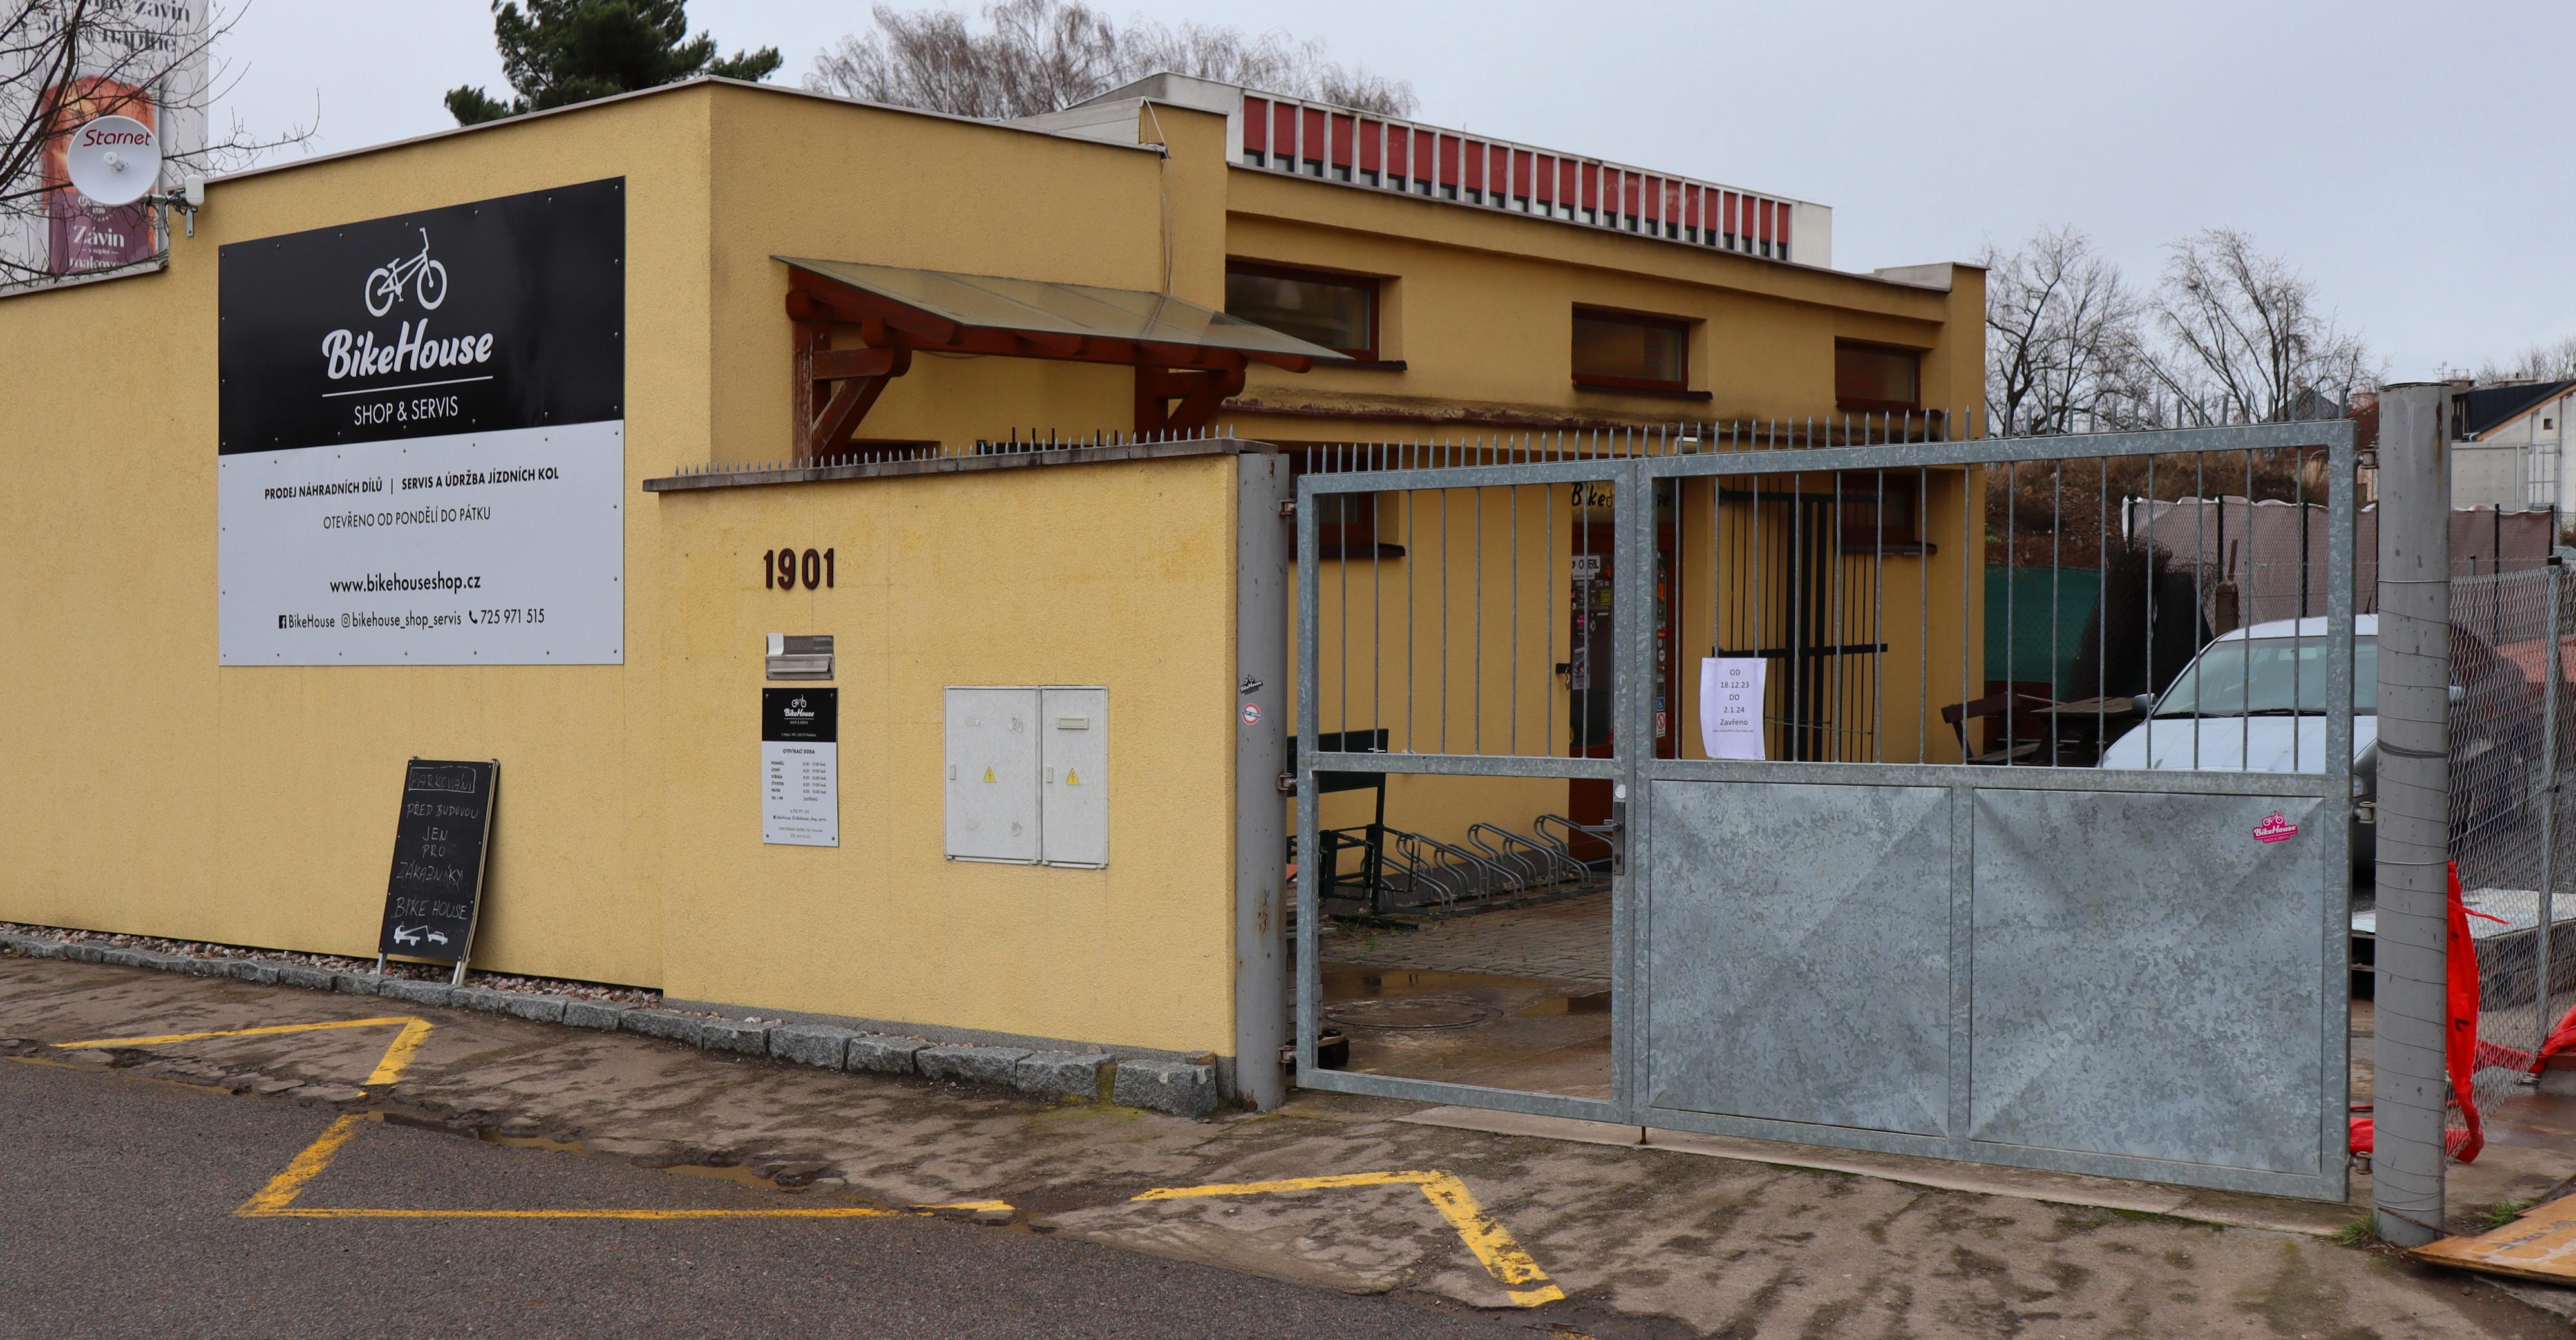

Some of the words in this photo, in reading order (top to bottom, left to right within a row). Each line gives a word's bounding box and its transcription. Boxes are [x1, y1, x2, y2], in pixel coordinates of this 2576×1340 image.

[83, 129, 151, 147] Starnet
[73, 225, 124, 248] Závin
[322, 318, 494, 379] BikeHouse
[354, 403, 393, 426] SHOP
[397, 401, 408, 421] &
[412, 396, 459, 420] SERVIS
[265, 486, 297, 500] PRODEJ
[299, 479, 359, 497] NÁHRADNÍCH
[362, 475, 383, 493] DÍLŮ
[401, 476, 433, 490] SERVIS
[435, 475, 442, 487] A
[445, 469, 486, 487] ÚDRŽBA
[488, 465, 535, 484] JÍZDNÍCH
[538, 467, 559, 481] KOL
[323, 511, 375, 529] OTEVŘENO
[377, 513, 393, 526] OD
[395, 505, 438, 525] PONDĚLÍ
[441, 508, 457, 522] DO
[460, 503, 491, 521] PÁTKU
[763, 548, 834, 590] 1901
[330, 571, 481, 595] www.bikehouseshop.cz
[289, 613, 335, 628] BikeHouse
[352, 609, 461, 630] bikehouse_shop_servis
[480, 609, 500, 624] 725
[504, 609, 521, 624] 971
[526, 608, 545, 624] 515
[784, 708, 815, 717] BikeHouse
[406, 801, 433, 819] PŘED
[435, 804, 479, 819] BUDOVOU
[422, 825, 448, 841] JEN
[2254, 825, 2297, 836] BikeHouse
[422, 844, 446, 859] PRO
[393, 896, 429, 918] BIKE
[432, 899, 468, 920] HOUSE
